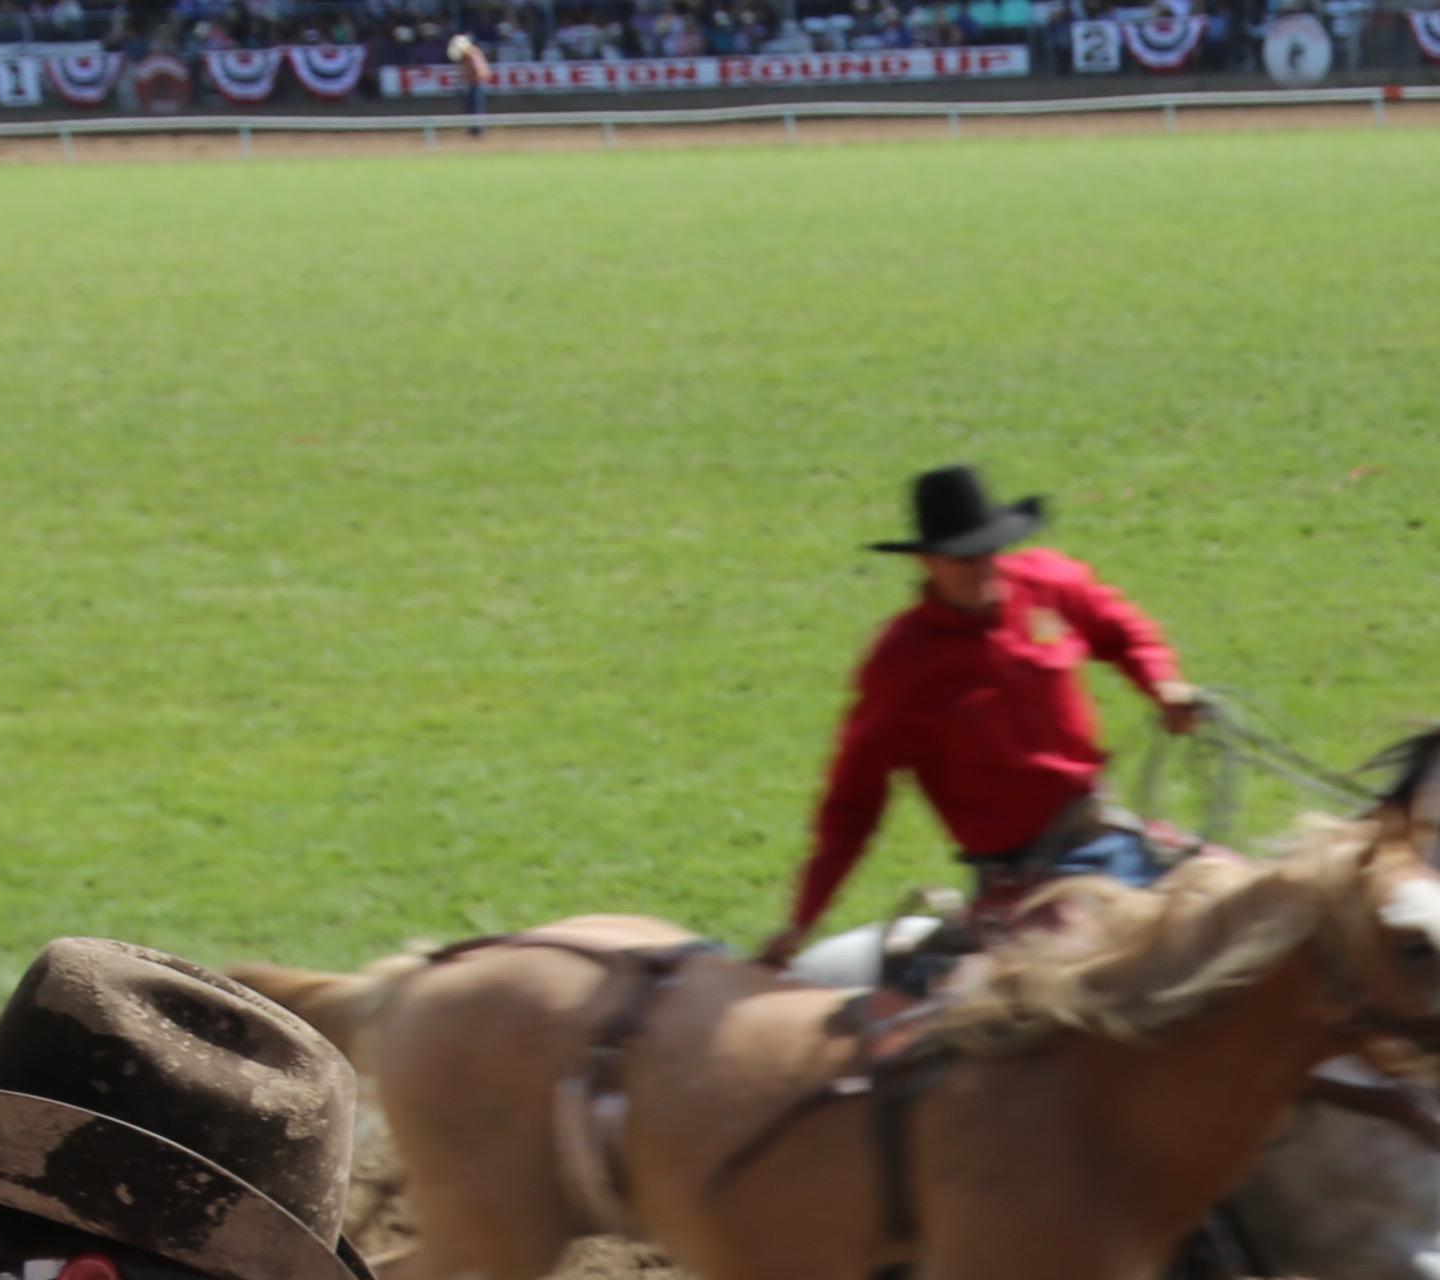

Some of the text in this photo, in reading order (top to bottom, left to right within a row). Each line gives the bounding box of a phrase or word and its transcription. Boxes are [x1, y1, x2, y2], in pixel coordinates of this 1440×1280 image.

[1083, 29, 1109, 62] 2
[718, 54, 909, 82] ROUND
[933, 49, 1009, 75] UP
